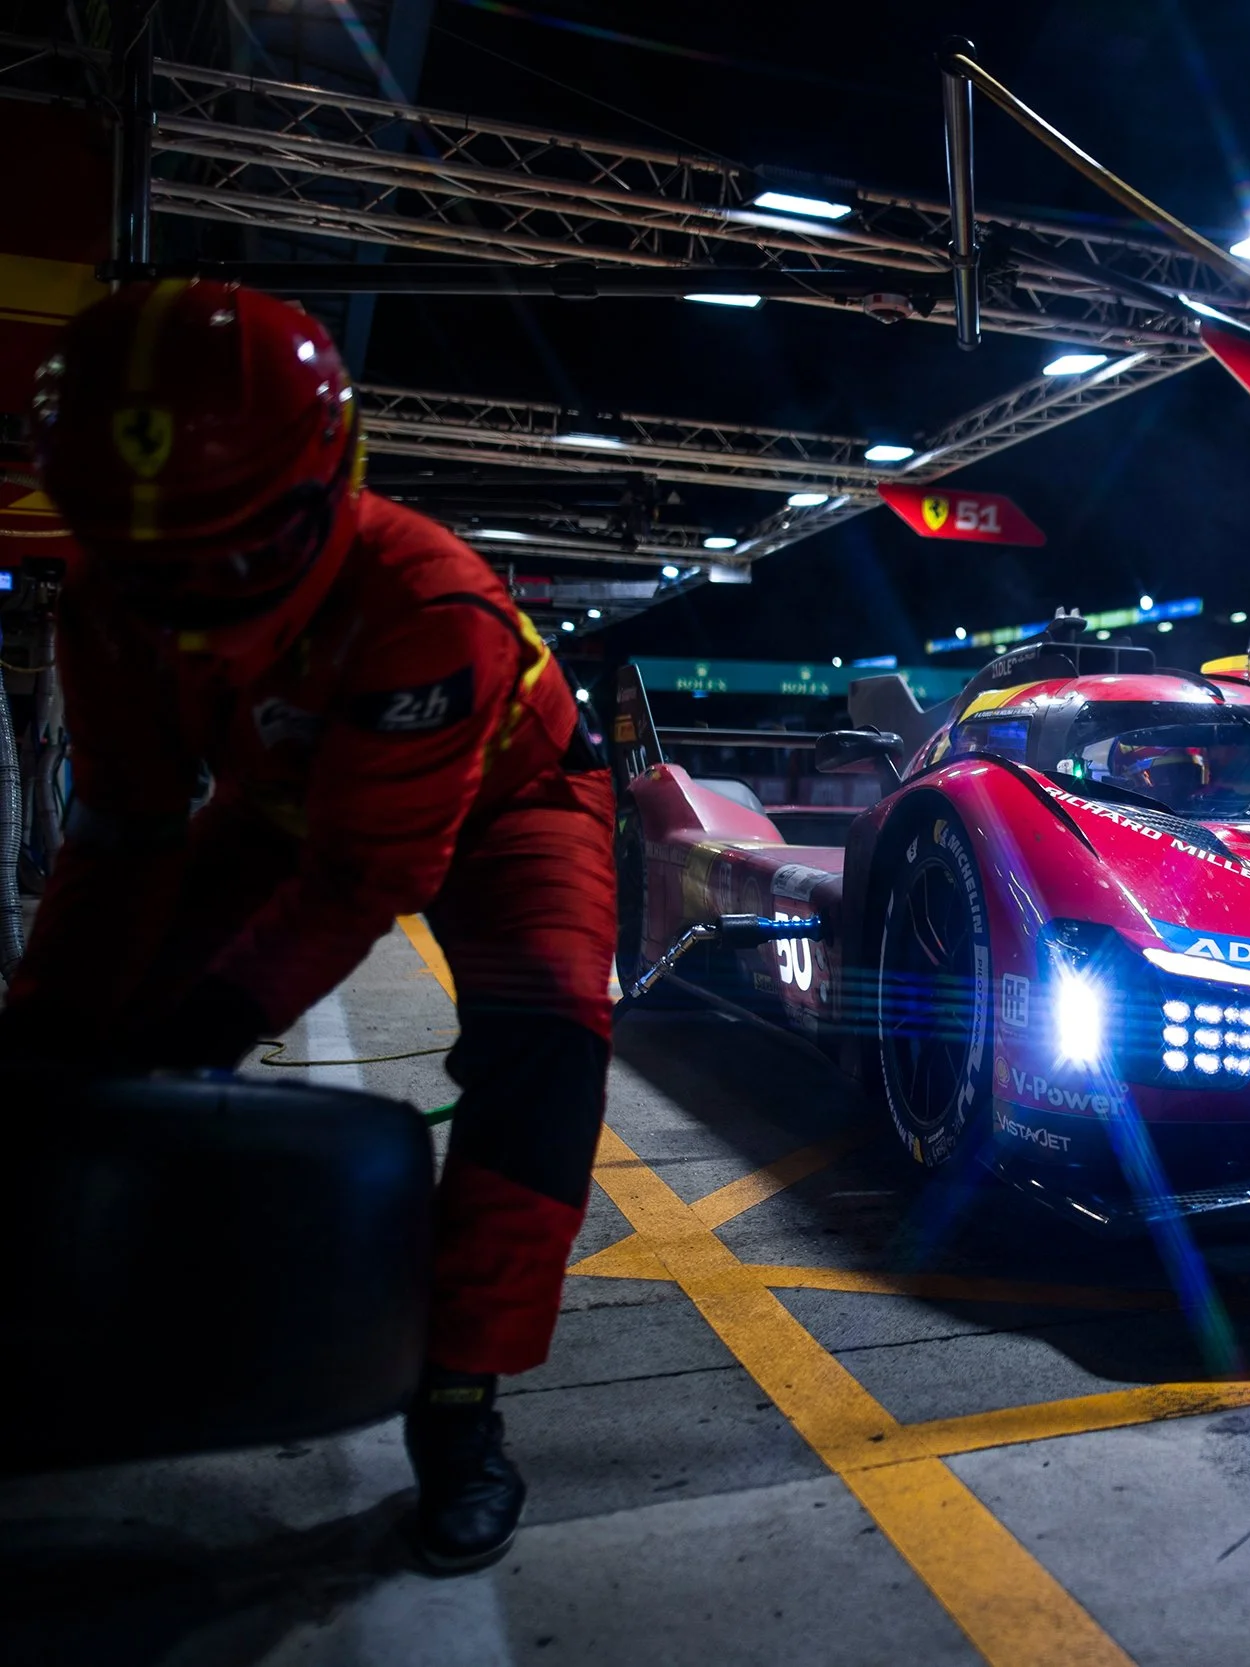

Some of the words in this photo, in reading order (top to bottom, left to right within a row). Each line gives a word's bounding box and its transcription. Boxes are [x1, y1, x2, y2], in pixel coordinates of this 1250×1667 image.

[955, 501, 1001, 534] 51
[1045, 786, 1162, 840] RICHARD
[947, 833, 983, 933] MICHELIN
[1011, 1067, 1127, 1115] V-Power
